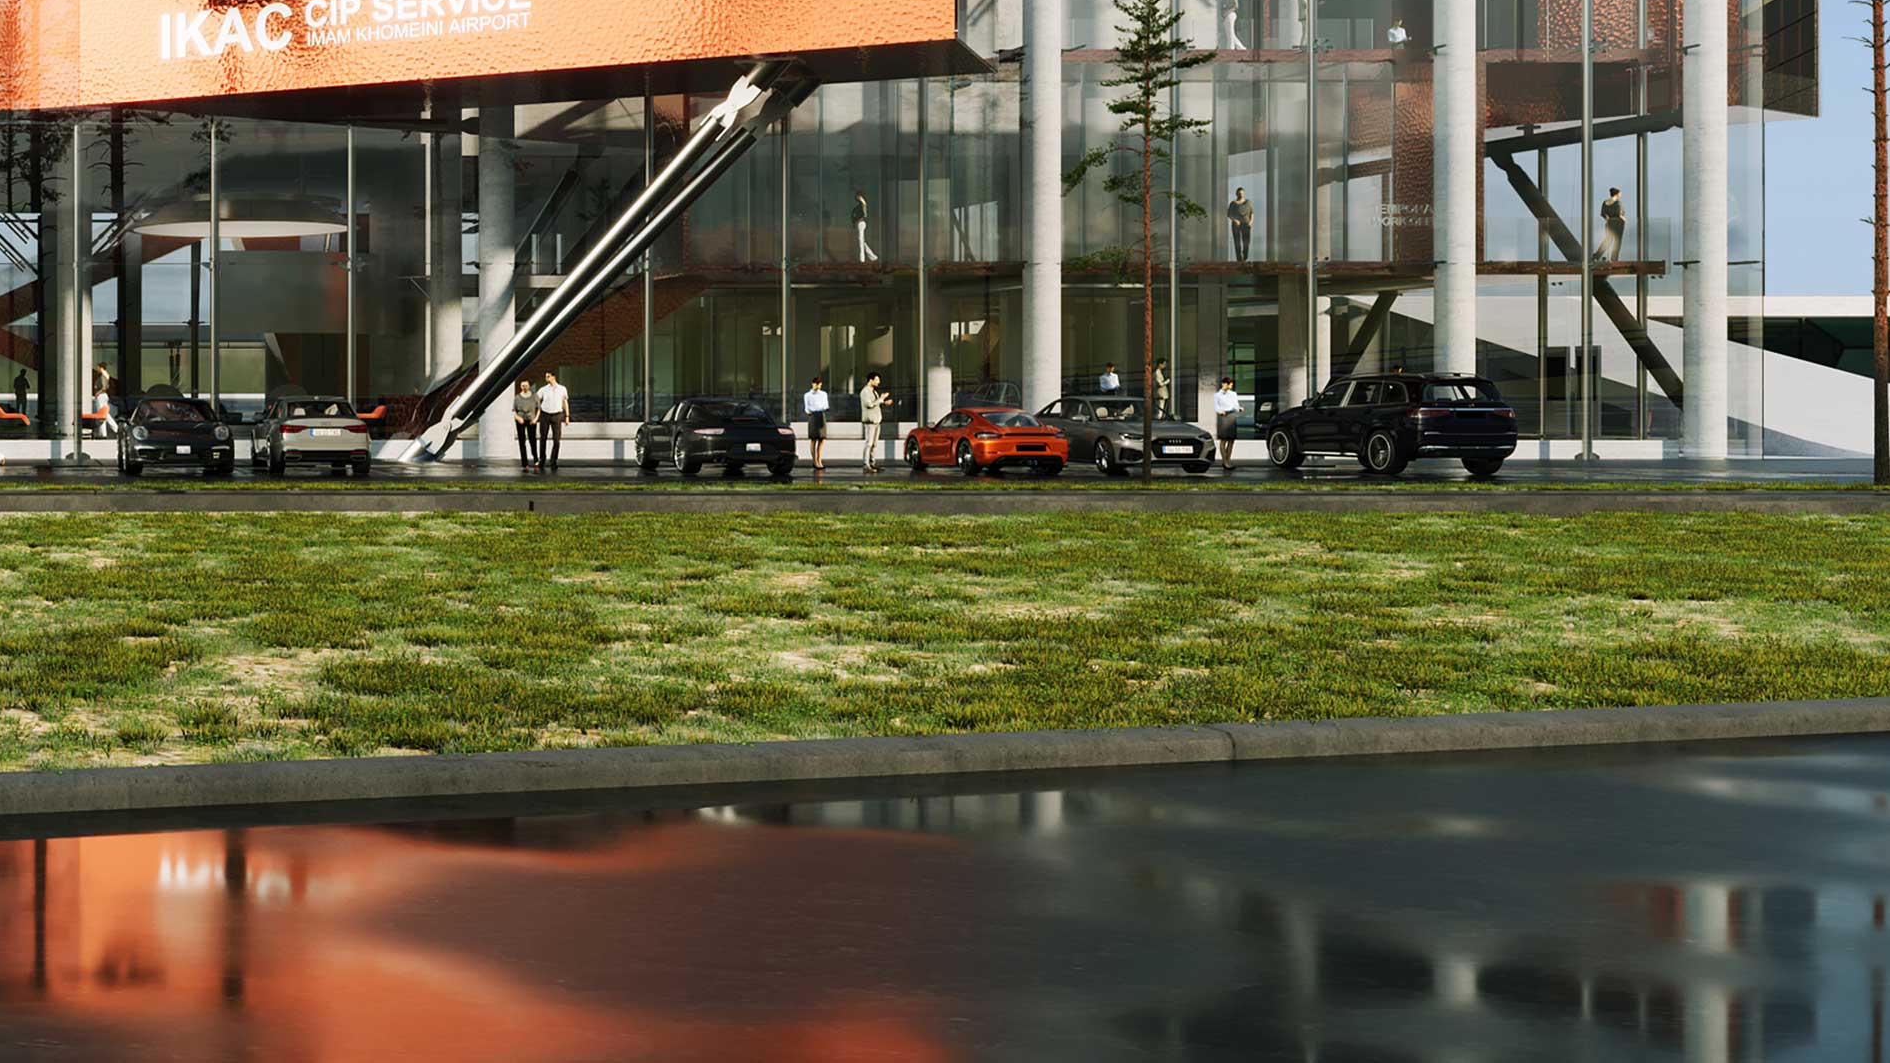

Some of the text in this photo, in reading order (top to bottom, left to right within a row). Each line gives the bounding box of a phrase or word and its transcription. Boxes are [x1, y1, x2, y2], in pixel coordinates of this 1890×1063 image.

[161, 2, 294, 60] IKAC
[307, 11, 531, 47] IMAM KHOMEINI AIRPORT
